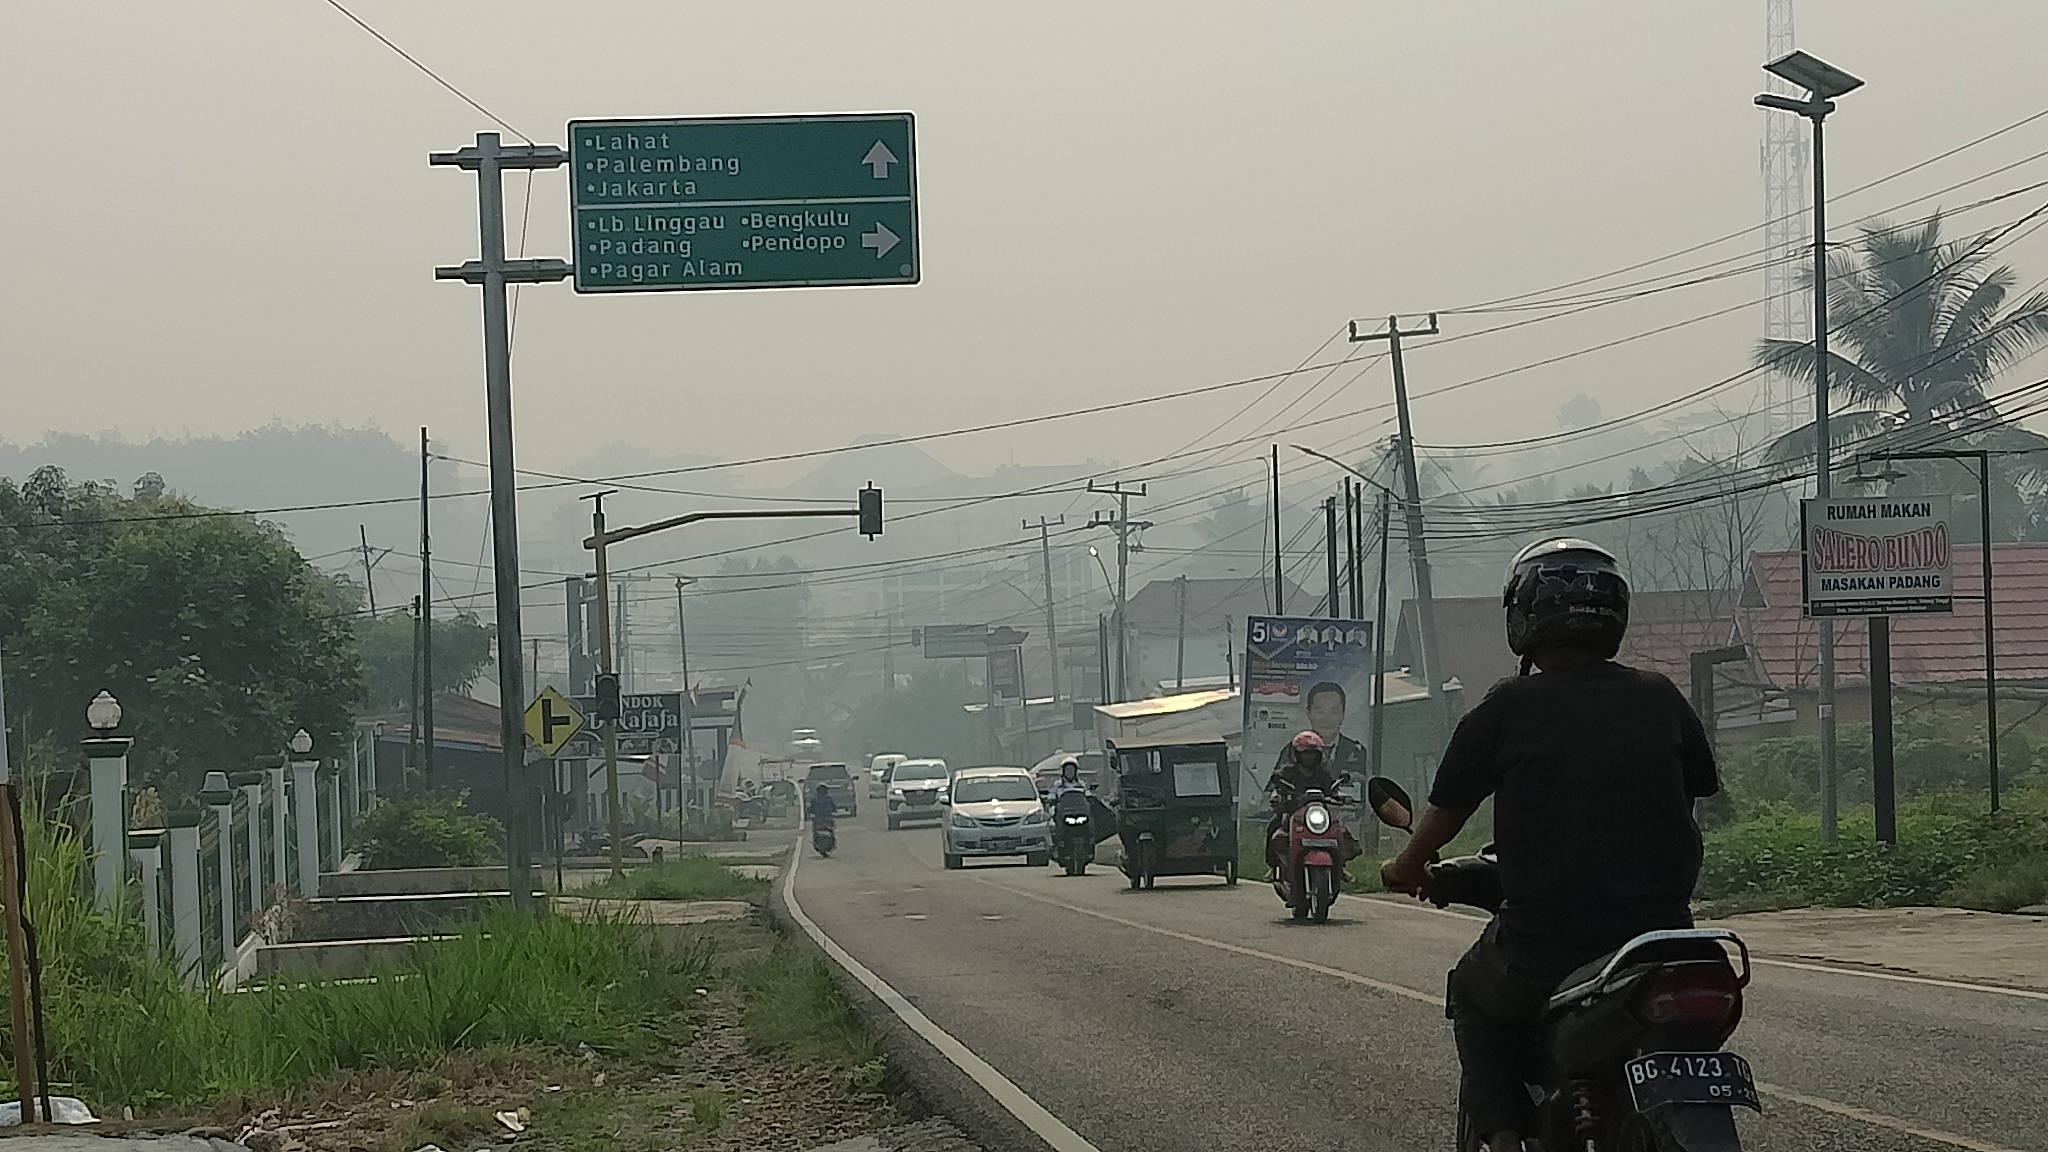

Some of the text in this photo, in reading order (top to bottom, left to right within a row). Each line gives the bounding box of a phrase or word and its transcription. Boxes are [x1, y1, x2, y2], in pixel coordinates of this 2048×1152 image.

[596, 133, 670, 151] Lahat
[597, 154, 740, 176] Palembang
[598, 179, 697, 197] Jakarta
[635, 214, 726, 235] Linggau
[750, 209, 850, 233] Bengkulu
[600, 237, 692, 258] Padang
[751, 233, 846, 254] Pendopo
[601, 259, 743, 283] Pagar Alam
[1827, 502, 1931, 521] RUMAH MAKAN
[1813, 522, 1949, 573] SALERO BUNDO
[1821, 574, 1941, 592] MASAKAN PADANG
[1252, 621, 1266, 643] 5
[621, 696, 663, 709] NDOK
[1670, 1056, 1722, 1078] 4123
[1709, 1085, 1732, 1097] 05
